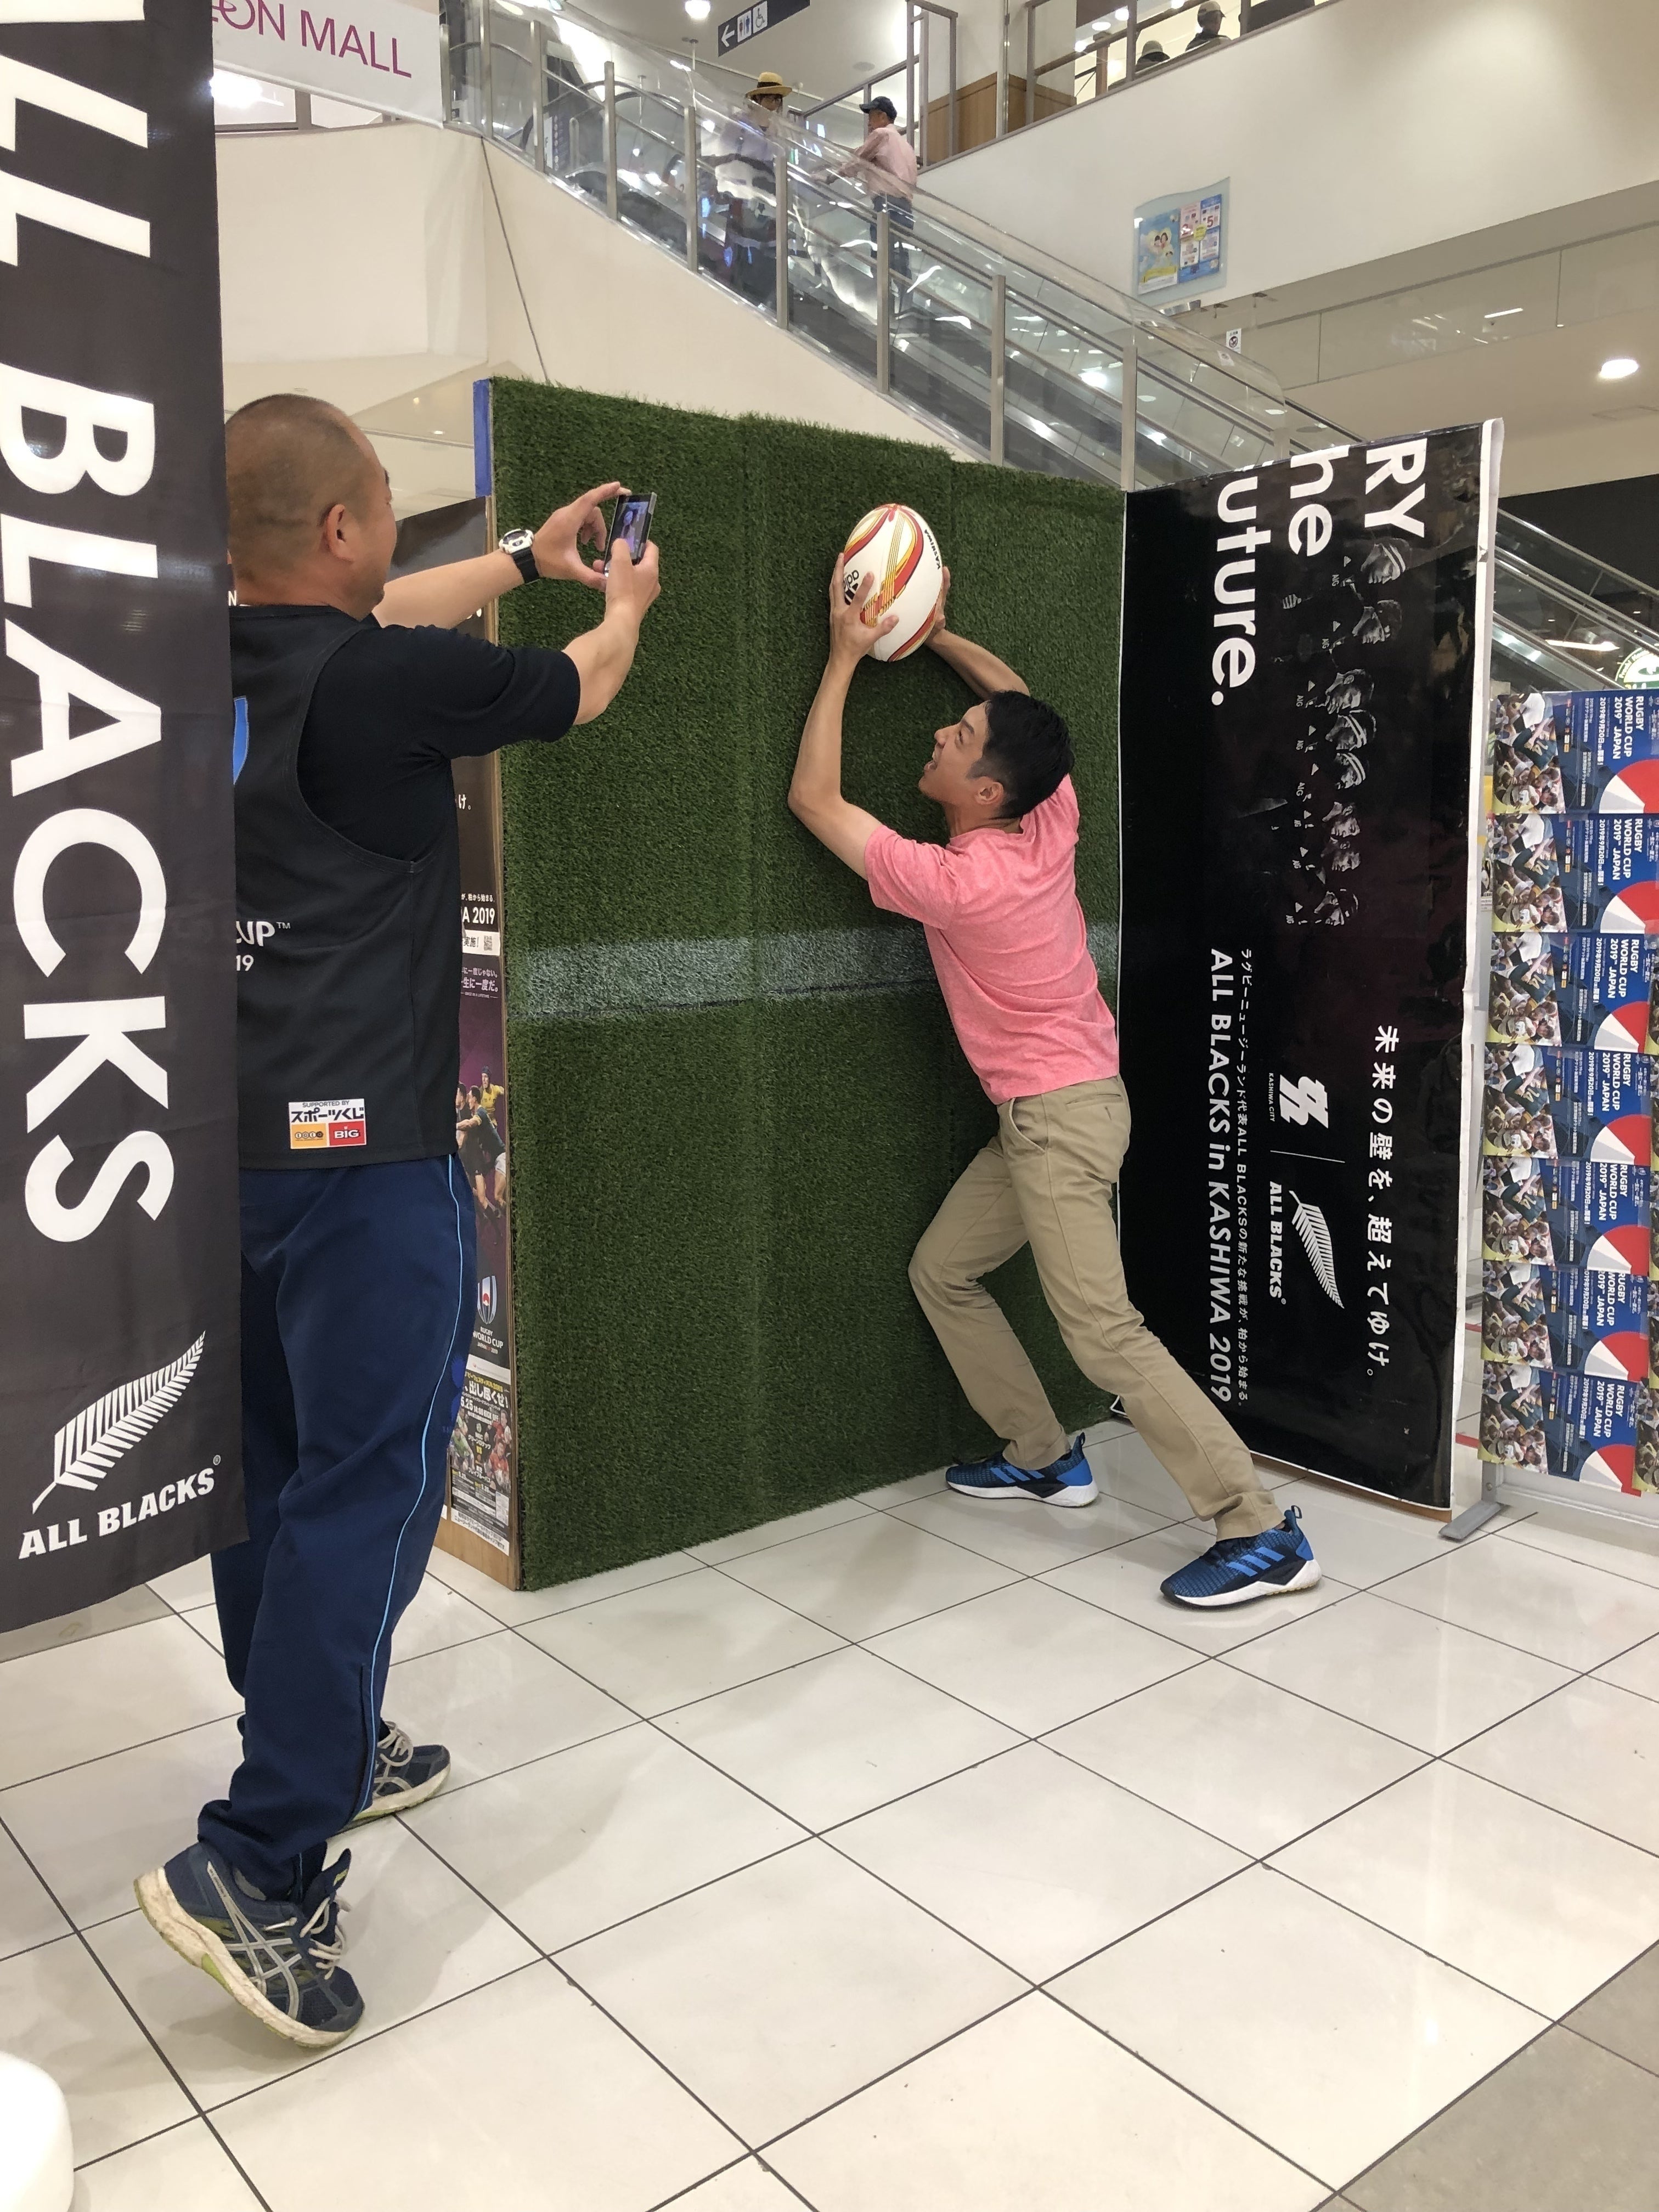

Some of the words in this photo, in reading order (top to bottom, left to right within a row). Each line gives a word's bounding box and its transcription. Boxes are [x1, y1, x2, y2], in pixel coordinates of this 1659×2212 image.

[300, 9, 411, 78] MALL
[0, 0, 150, 266] LL
[1364, 438, 1427, 538] RY
[1211, 462, 1272, 706] uture.
[1625, 696, 1633, 734] WORLD
[1613, 726, 1622, 759] JAPAN
[1624, 736, 1633, 757] CUP
[0, 363, 174, 1242] BLACKS
[1634, 819, 1643, 853] RUGBY
[472, 907, 495, 924] 2019
[236, 921, 290, 947] UP™
[1620, 939, 1629, 974] WORLD
[1630, 939, 1639, 973] RUGBY
[461, 977, 498, 992] 生に一度だ。
[1211, 948, 1234, 1001] ALL
[1608, 967, 1616, 998] JAPAN
[1618, 977, 1627, 997] CUP
[1208, 1014, 1232, 1133] BLACKS
[291, 1107, 364, 1122] スポーツくじ
[334, 1128, 361, 1139] BIG
[1208, 1143, 1231, 1170] in
[1269, 1181, 1282, 1215] ALL
[1367, 1025, 1400, 1376] 未来の壁を、超えてゆけ。
[1208, 1181, 1232, 1323] KASHIWA
[492, 1338, 504, 1348] CUP
[1209, 1333, 1232, 1402] 2019
[1605, 1384, 1614, 1417] WORLD
[1616, 1385, 1625, 1417] RUGBY
[1593, 1407, 1602, 1437] JAPAN
[19, 1518, 87, 1559] ALL
